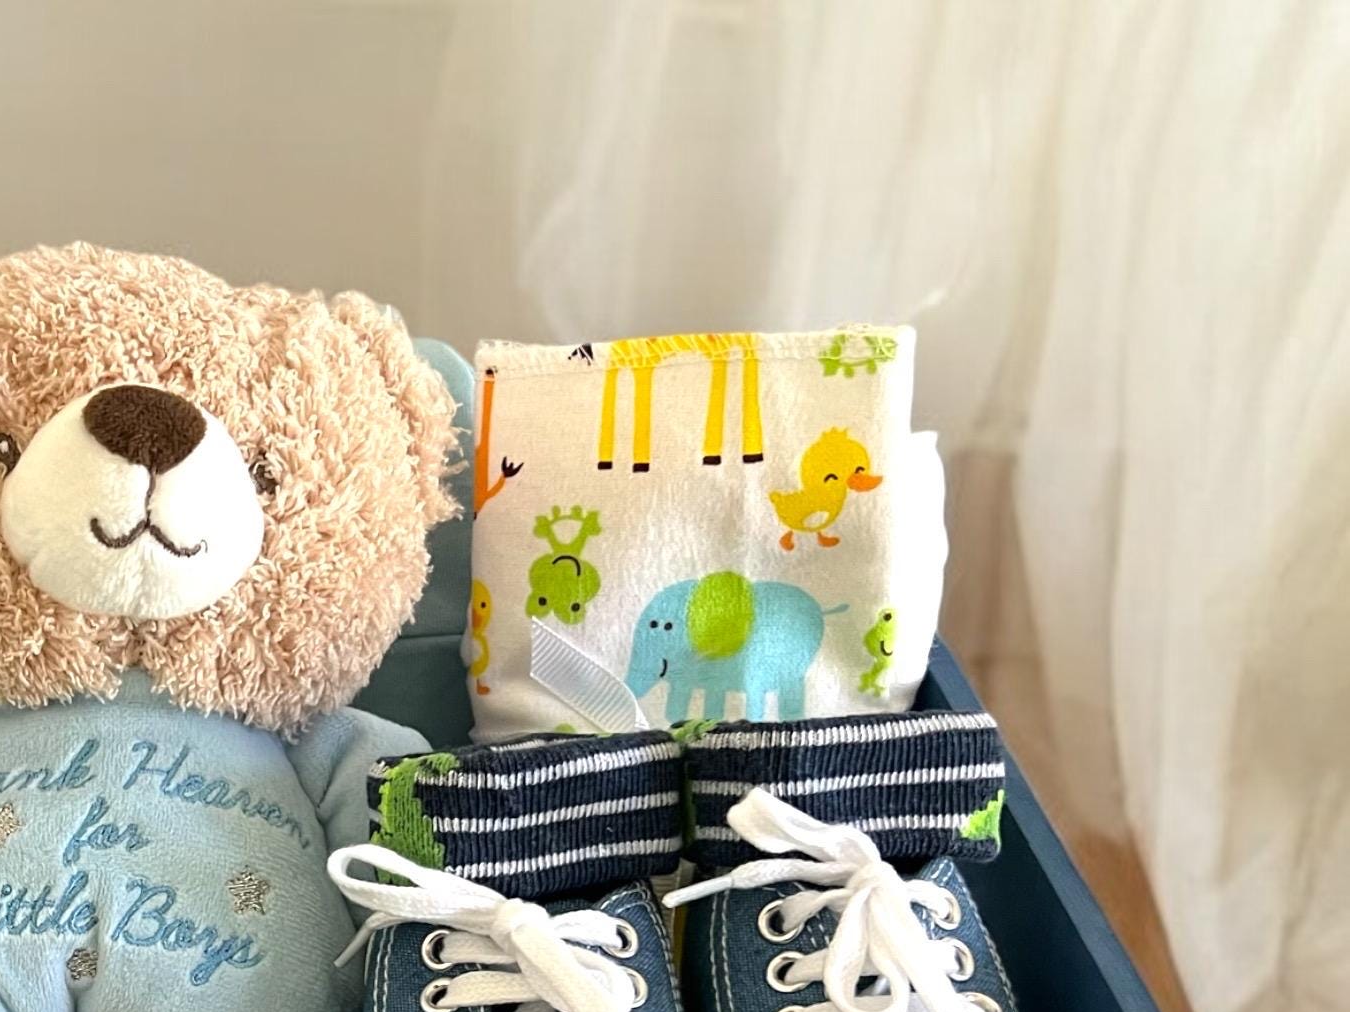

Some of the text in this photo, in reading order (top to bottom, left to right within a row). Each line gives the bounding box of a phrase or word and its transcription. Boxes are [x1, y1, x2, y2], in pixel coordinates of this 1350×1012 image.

[61, 796, 150, 867] for
[122, 741, 310, 850] Heaven
[110, 877, 265, 988] Boys
